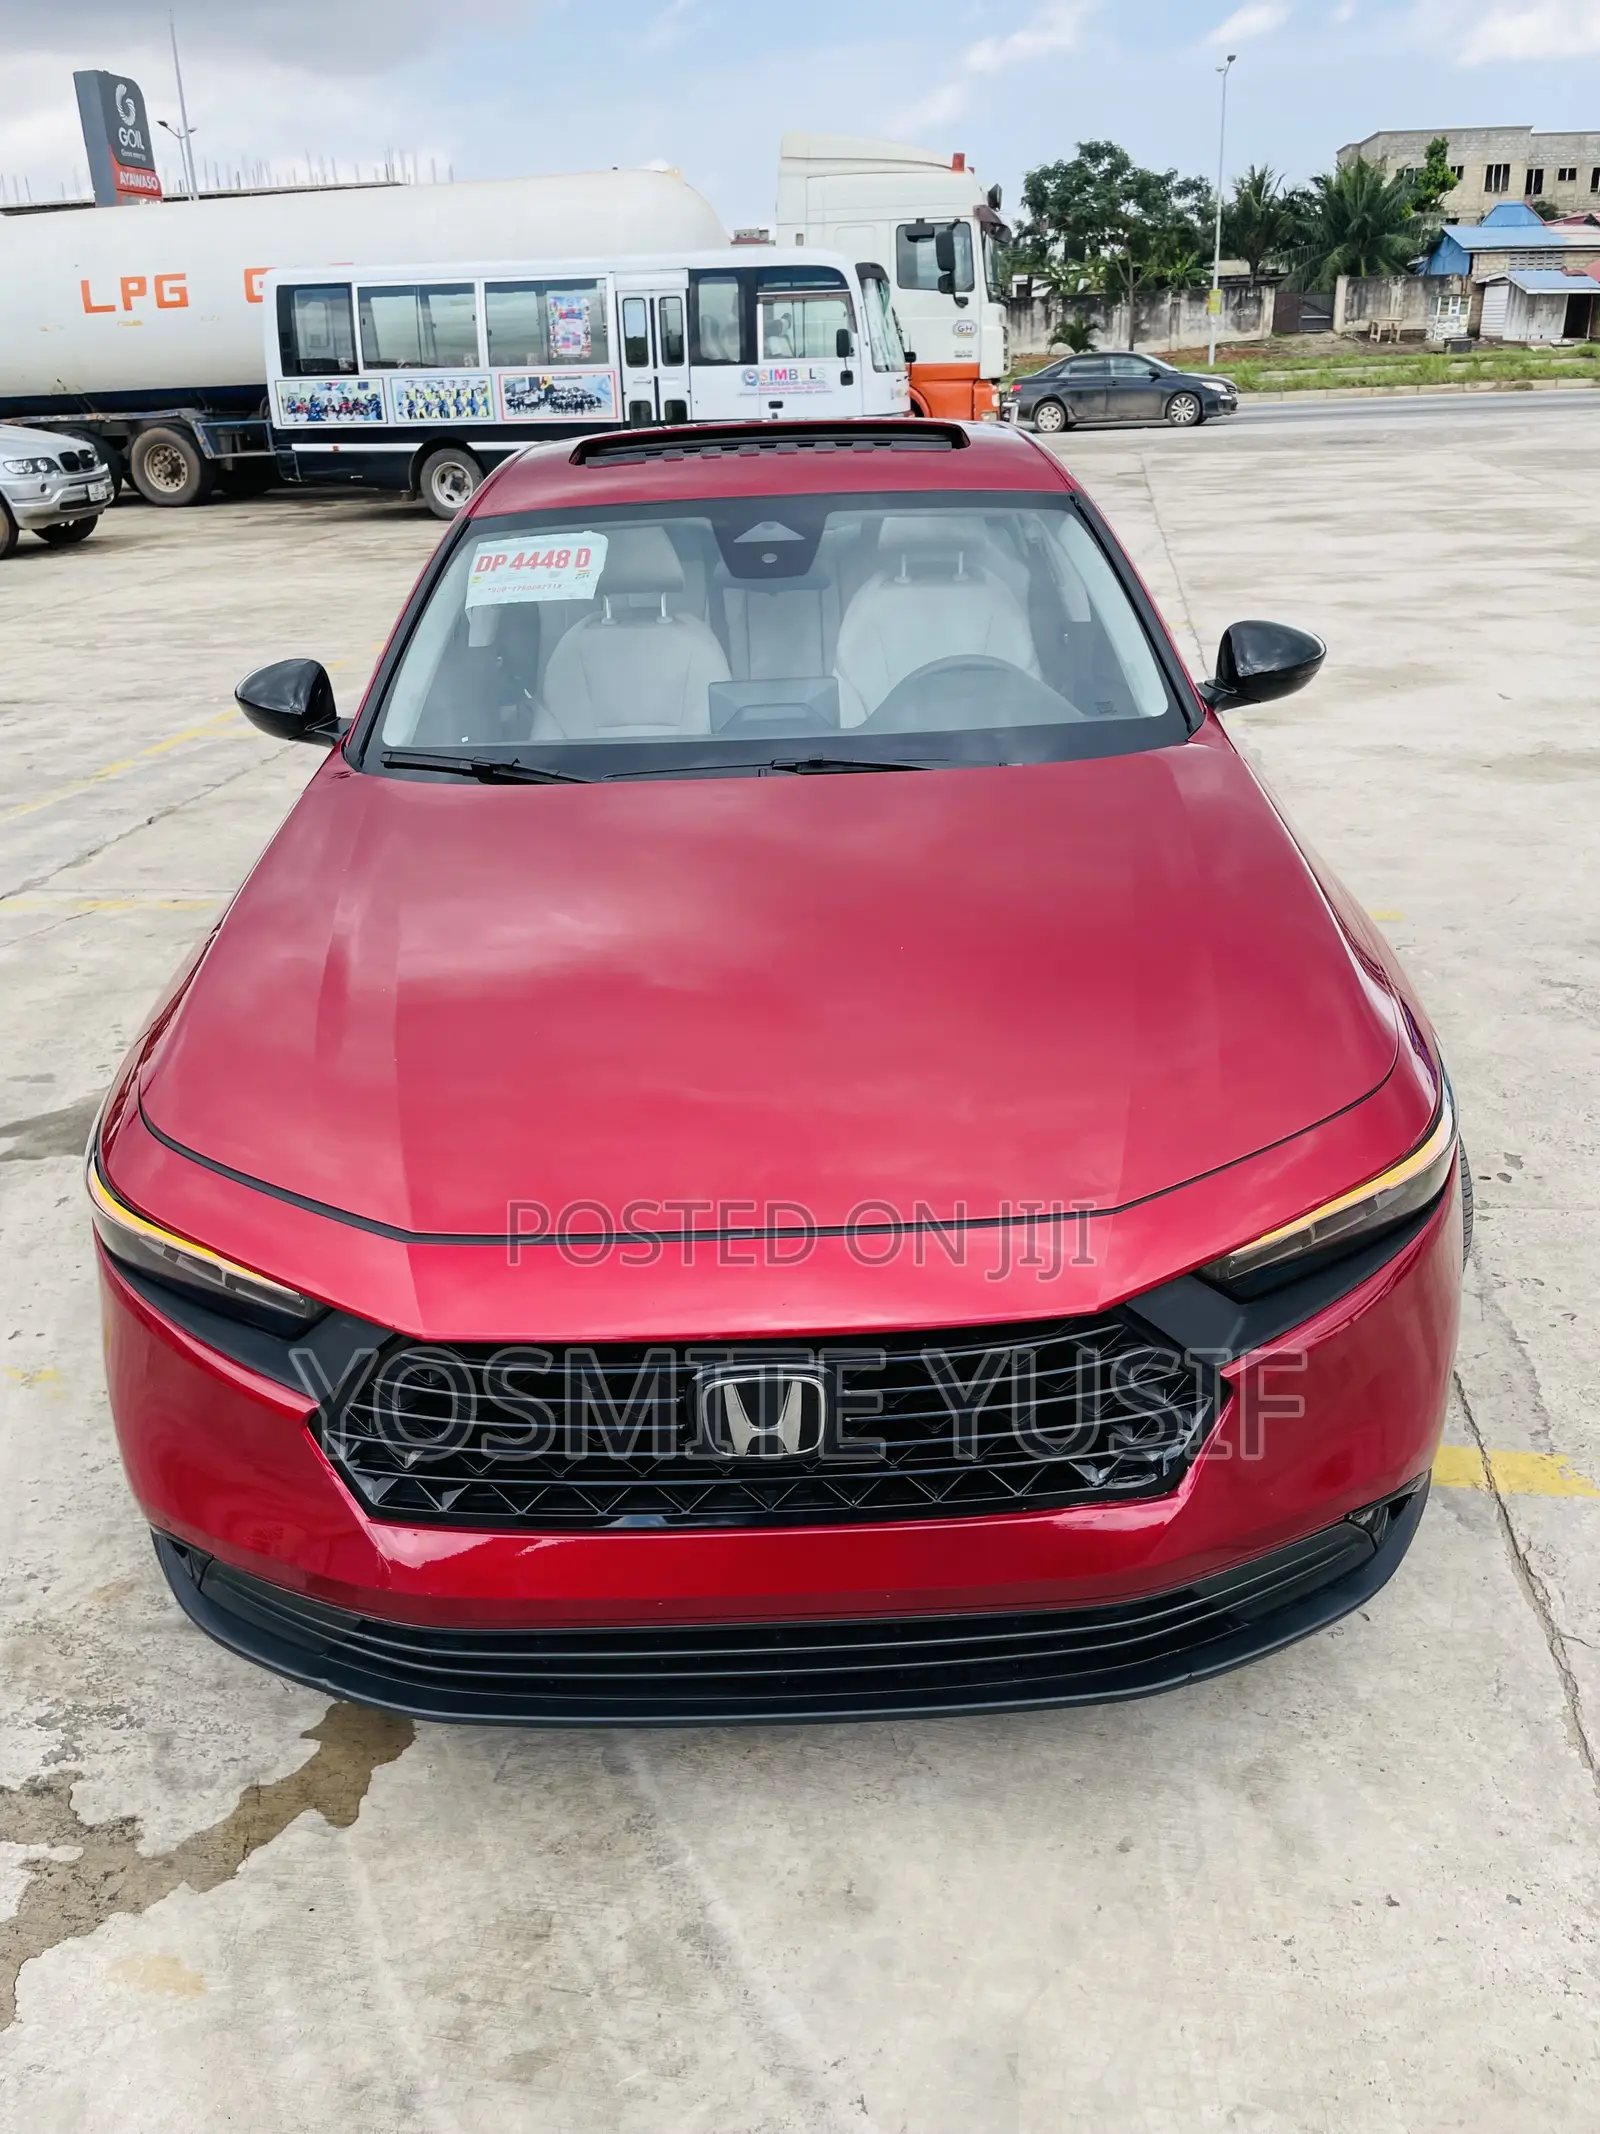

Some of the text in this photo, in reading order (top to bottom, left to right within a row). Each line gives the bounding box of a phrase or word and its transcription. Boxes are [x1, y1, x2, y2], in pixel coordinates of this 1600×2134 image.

[118, 127, 145, 151] GOIL
[120, 171, 159, 190] AYAWASO
[80, 273, 189, 314] LPG
[474, 547, 591, 573] DP 4448 D
